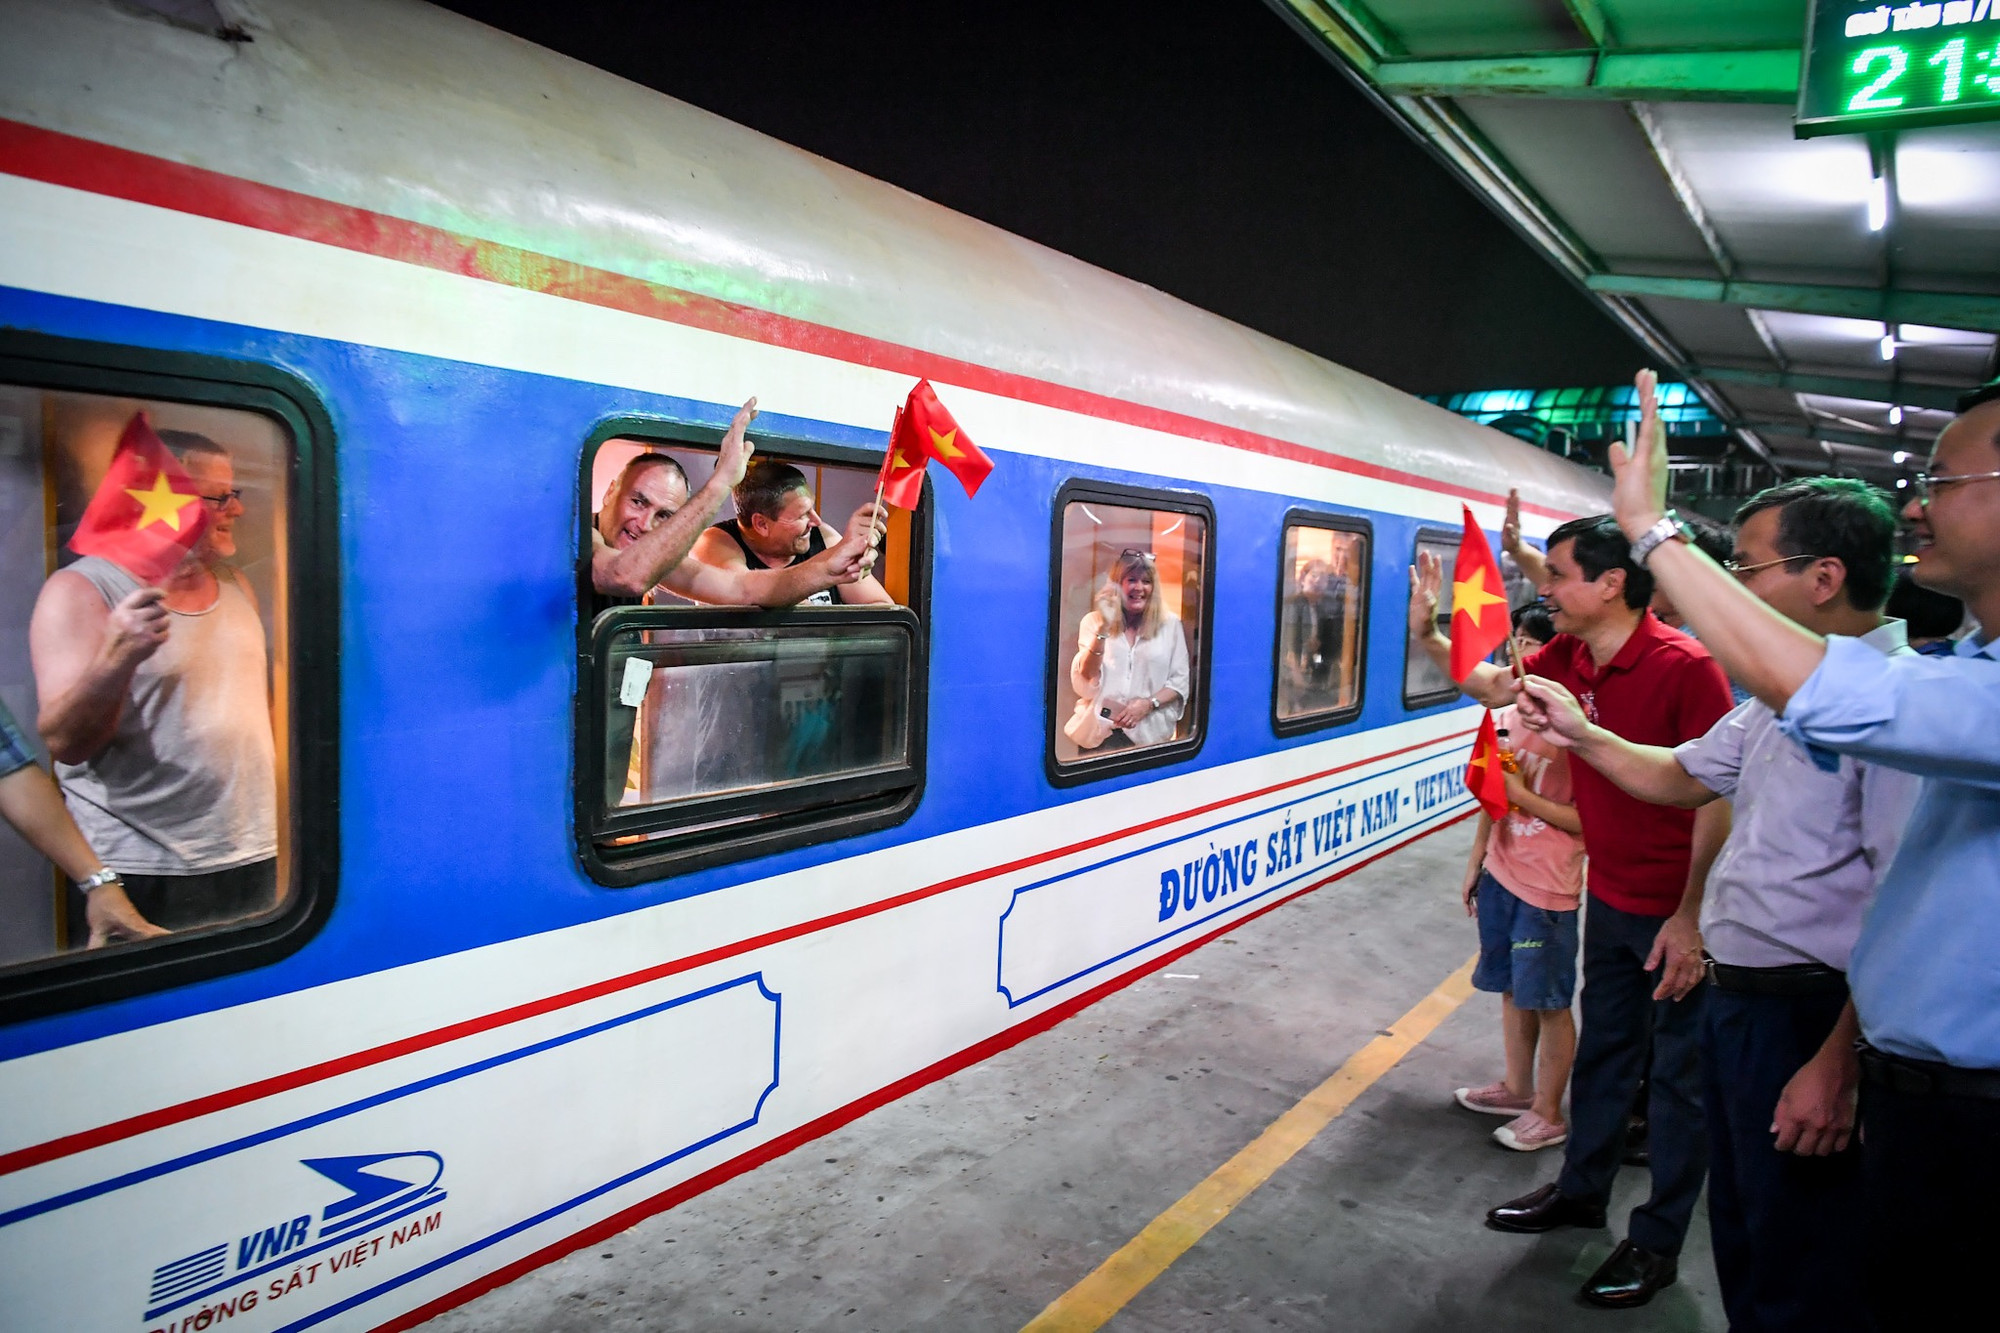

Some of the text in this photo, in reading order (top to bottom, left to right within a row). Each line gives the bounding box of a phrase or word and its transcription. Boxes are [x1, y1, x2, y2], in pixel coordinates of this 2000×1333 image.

[1847, 38, 2000, 111] 21:
[1158, 841, 1257, 922] ĐƯỜNG
[1266, 809, 1307, 877] SẮT
[1313, 799, 1356, 856] VIỆT
[1361, 788, 1399, 837] NAM
[148, 1211, 441, 1333] ƯỜNG SẮT VIỆT NAM
[237, 1214, 312, 1270] VNR
